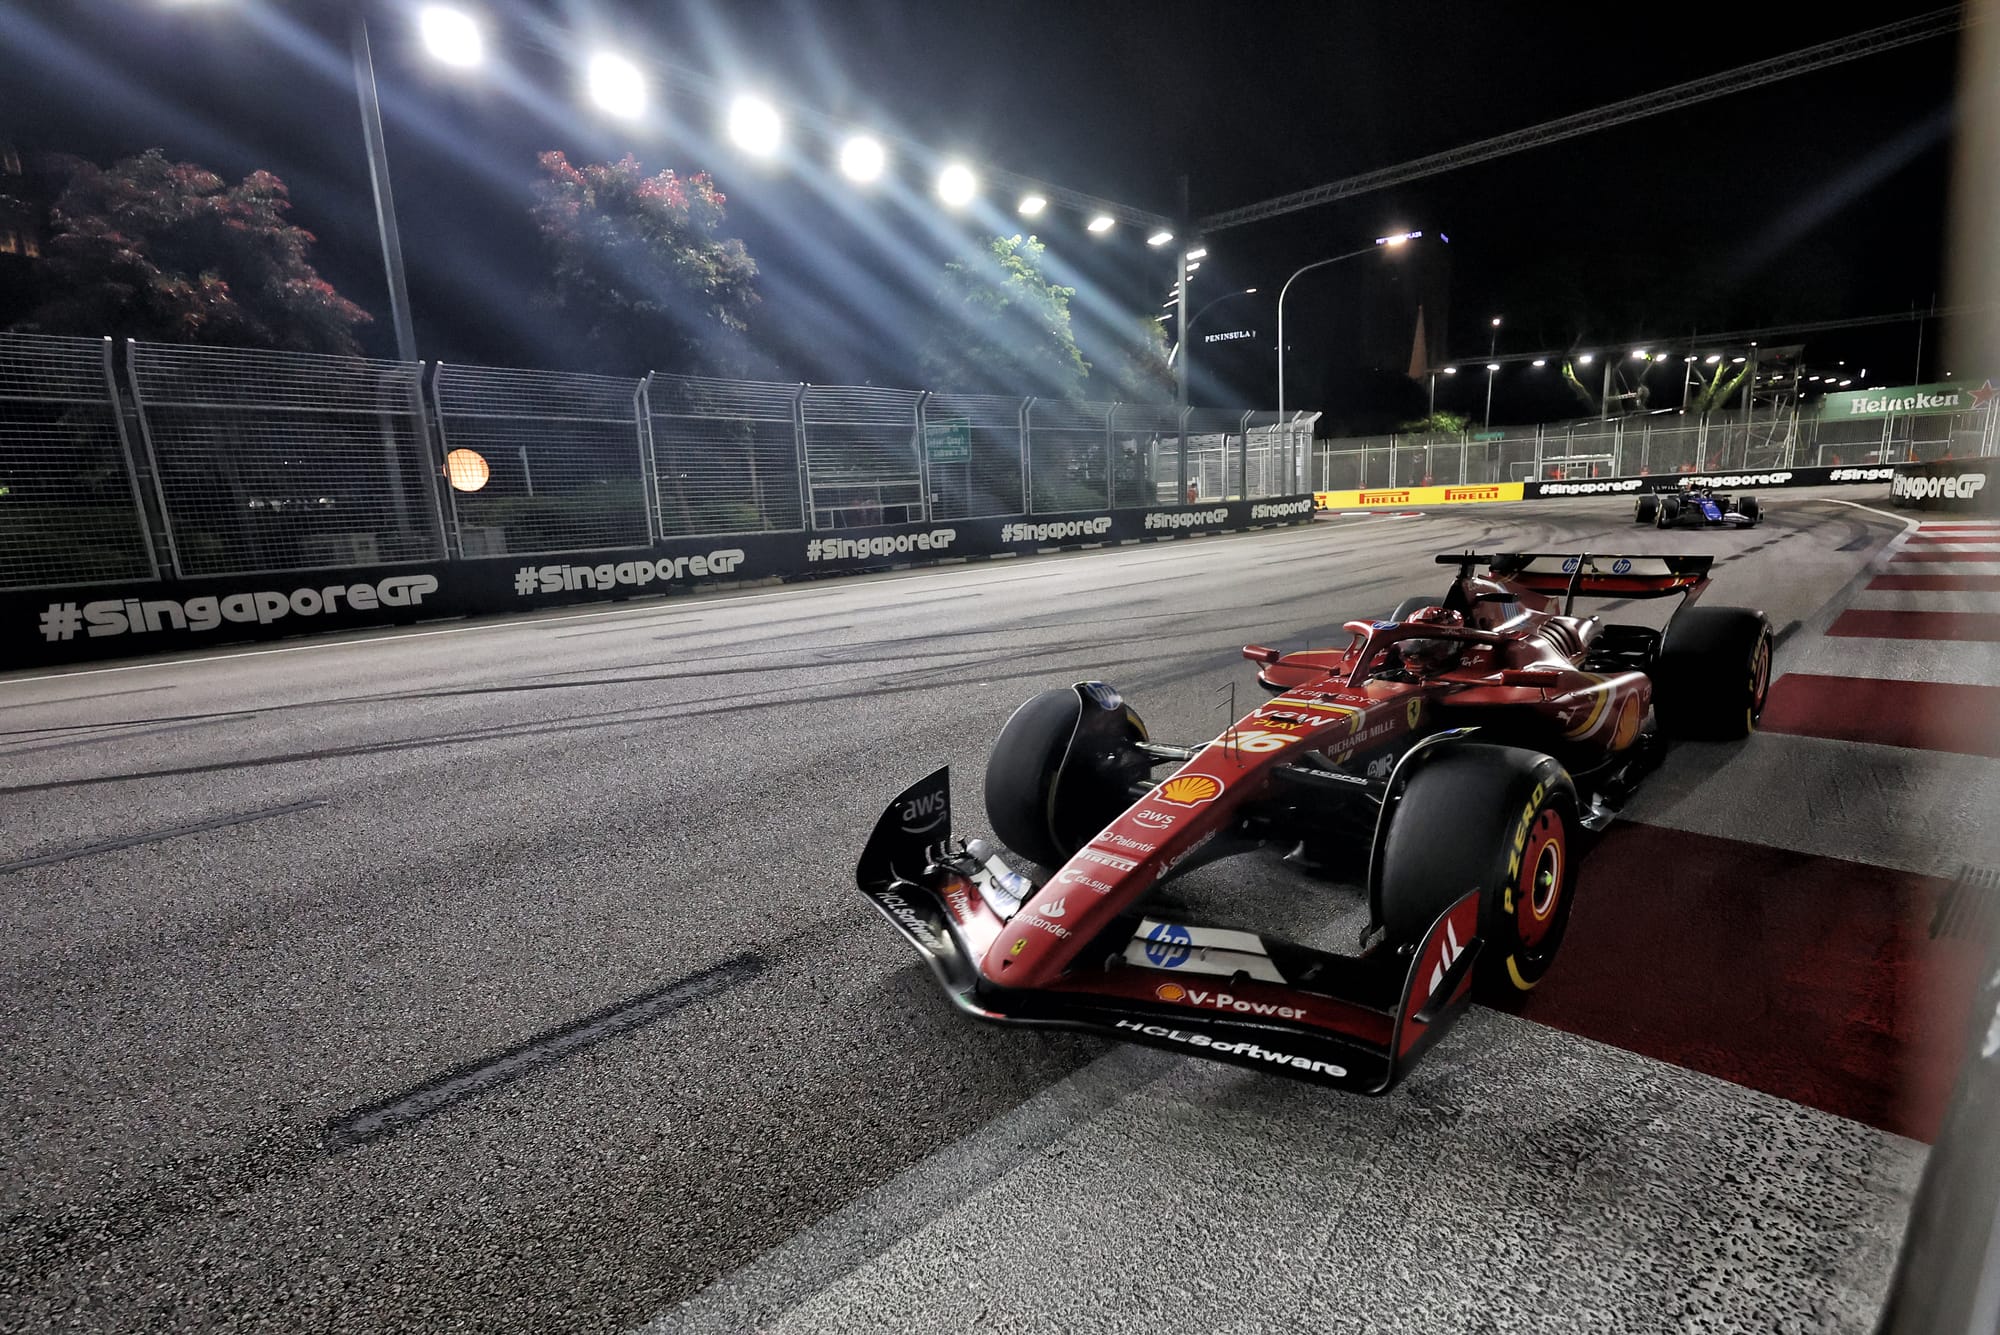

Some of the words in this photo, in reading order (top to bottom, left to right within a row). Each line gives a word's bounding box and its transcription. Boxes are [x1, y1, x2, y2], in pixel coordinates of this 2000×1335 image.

[1205, 330, 1250, 343] PENINSULA
[1851, 393, 1960, 414] Heineken
[1359, 491, 1410, 504] PIRELLI
[1445, 487, 1499, 501] PIRELLI
[1539, 480, 1643, 495] #SingaporeGP
[1145, 508, 1229, 529] #SingaporeGP
[1251, 499, 1311, 519] #SingaporeGP
[1001, 516, 1112, 543] #SingaporeGP
[806, 528, 956, 562] #SingaporeGP
[514, 548, 745, 596] #SingaporeGP
[1613, 558, 1631, 574] hp
[39, 573, 438, 643] #SingaporeGP
[1253, 718, 1303, 731] PLAY
[1328, 732, 1368, 757] RICHARD
[1369, 719, 1396, 738] MILLE
[901, 789, 946, 823] aws
[1137, 808, 1177, 825] aws
[1111, 834, 1157, 853] Palantir
[1079, 848, 1139, 873] PIRELLI
[1074, 873, 1113, 893] CELSIUS
[1504, 887, 1515, 914] P
[1147, 923, 1192, 967] hp
[1187, 989, 1307, 1021] V-Power
[1115, 1019, 1349, 1079] HCLSoftware
